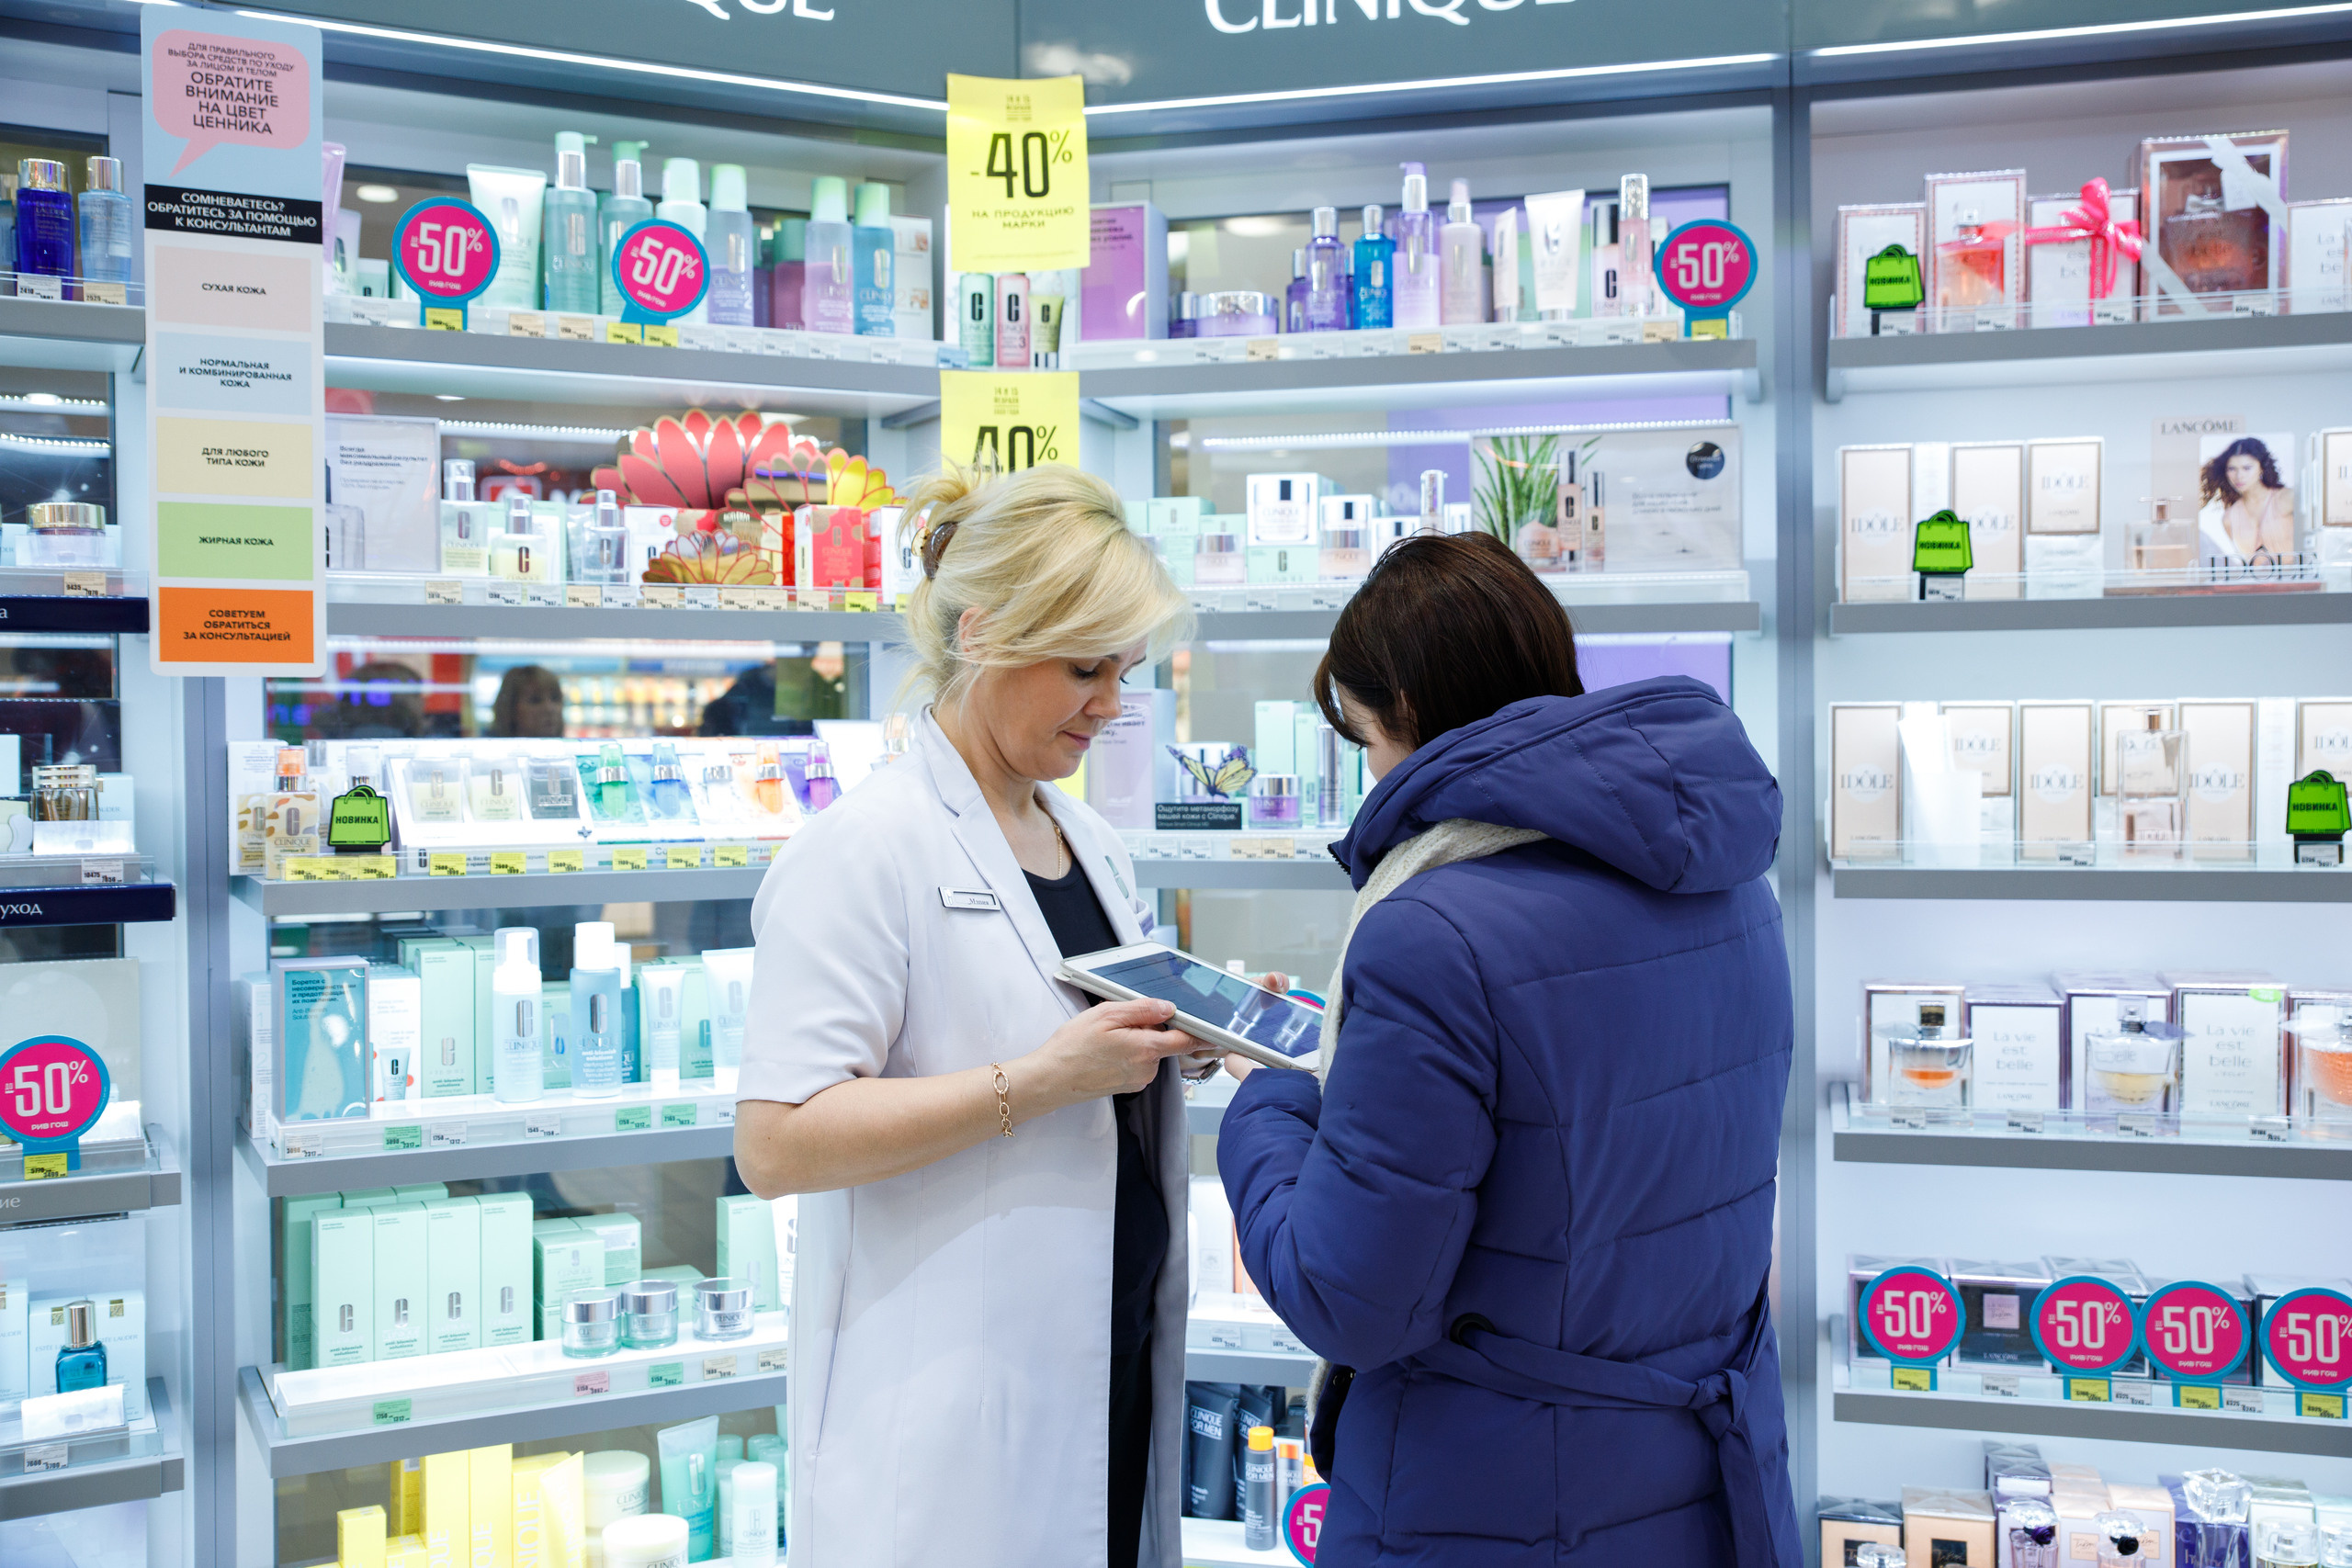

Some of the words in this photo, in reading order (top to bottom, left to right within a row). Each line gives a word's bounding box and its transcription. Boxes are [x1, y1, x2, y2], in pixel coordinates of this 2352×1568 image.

[1204, 0, 1577, 34] CLINIQ
[187, 42, 208, 51] ДЛЯ
[209, 45, 275, 61] ПРАВИЛЬНОГО
[168, 49, 206, 61] ВЫБОРА
[208, 52, 247, 65] СРЕДСТВ
[249, 59, 263, 67] ПО
[266, 61, 294, 72] УХОДУ
[187, 60, 198, 68] ЗА
[199, 61, 234, 73] ЛИЦОМ
[246, 68, 277, 77] ТЕЛОМ
[190, 71, 273, 93] ОБРАТИТЕ
[186, 85, 279, 107] ВНИМАНИЕ
[198, 100, 221, 115] НА
[226, 104, 266, 120] ЦВЕТ
[193, 114, 273, 135] ЦЕННИКА
[970, 130, 1072, 198] -40%
[181, 192, 285, 212] СОМНЕВАЕТЕСЬ?
[147, 201, 225, 219] ОБРАТИТЕСЬ
[228, 210, 243, 220] ЗА
[245, 211, 317, 228] ПОМОЩЬЮ
[972, 209, 989, 219] НА
[994, 207, 1074, 220] ПРОДУКЦИЮ
[175, 217, 184, 227] К
[187, 218, 291, 237] КОНСУЛЬТАНТАМ
[1002, 220, 1045, 229] МАРКИ
[201, 283, 234, 293] СУХАЯ
[236, 285, 266, 295] КОЖА
[199, 357, 269, 369] НОРМАЛЬНАЯ
[188, 367, 292, 381] КОМБИНИРОВАННАЯ
[220, 378, 250, 389] КОЖА
[2160, 418, 2237, 435] LANCÔME
[201, 447, 222, 456] ДЛЯ
[225, 448, 269, 458] ЛЮБОГО
[206, 457, 232, 466] ТИПА
[234, 458, 266, 468] КОЖИ
[1851, 513, 1905, 534] IDÔLE
[1964, 512, 2015, 532] DÔLE
[198, 536, 242, 545] ЖИРНАЯ
[243, 537, 274, 547] КОЖА
[1918, 541, 1962, 550] НОВИНКА
[209, 609, 266, 618] СОВЕТУЕМ
[203, 621, 271, 630] ОБРАТИТЬСЯ
[183, 631, 197, 640] ЗА
[199, 631, 291, 642] КОНСУЛЬТАЦИЕЙ
[2314, 731, 2352, 749] IDÔL
[1840, 770, 1894, 789] IDÔLE
[2030, 770, 2084, 789] IDÔLE
[2189, 769, 2245, 789] IDÔLE
[1157, 805, 1188, 813] Ощутите
[1191, 806, 1239, 814] метаморфозу
[2292, 802, 2338, 812] НОВИНКА
[335, 815, 379, 824] НОВИНКА
[274, 837, 311, 847] CLINIQUE
[0, 903, 43, 919] уход
[292, 983, 356, 991] несовершенстми
[1996, 1058, 2033, 1071] belle
[2209, 1055, 2252, 1067] belle
[31, 1122, 50, 1131] РИВ
[51, 1121, 69, 1129] ГОШ
[1190, 1407, 1223, 1427] CLINIQUE
[1204, 1422, 1222, 1437] MEN
[1246, 1462, 1274, 1472] CLINIQUE
[1260, 1472, 1274, 1480] MEN
